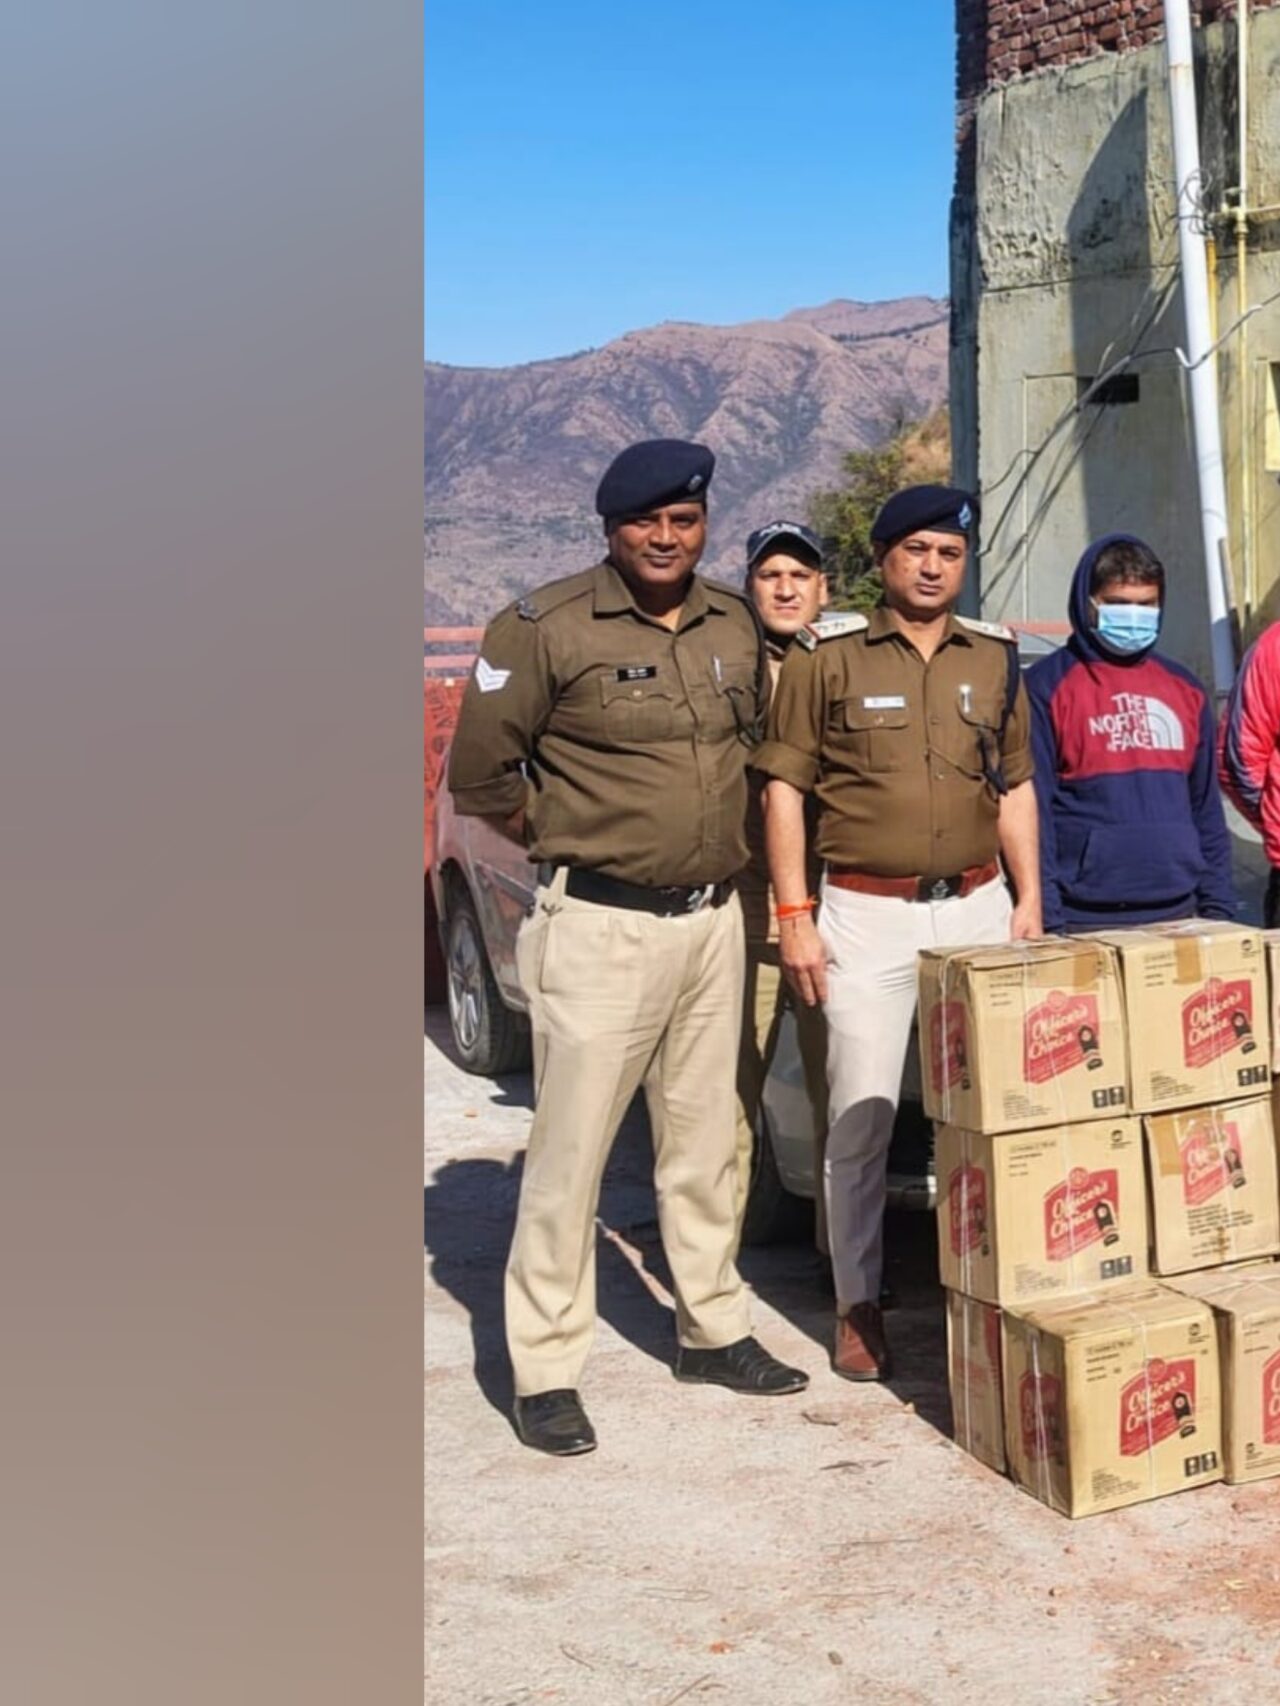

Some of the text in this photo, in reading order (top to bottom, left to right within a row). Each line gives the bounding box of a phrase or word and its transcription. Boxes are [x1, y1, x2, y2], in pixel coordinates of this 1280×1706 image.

[1110, 692, 1146, 714] THE
[1088, 711, 1150, 736] NORTH
[1108, 728, 1153, 753] FACE
